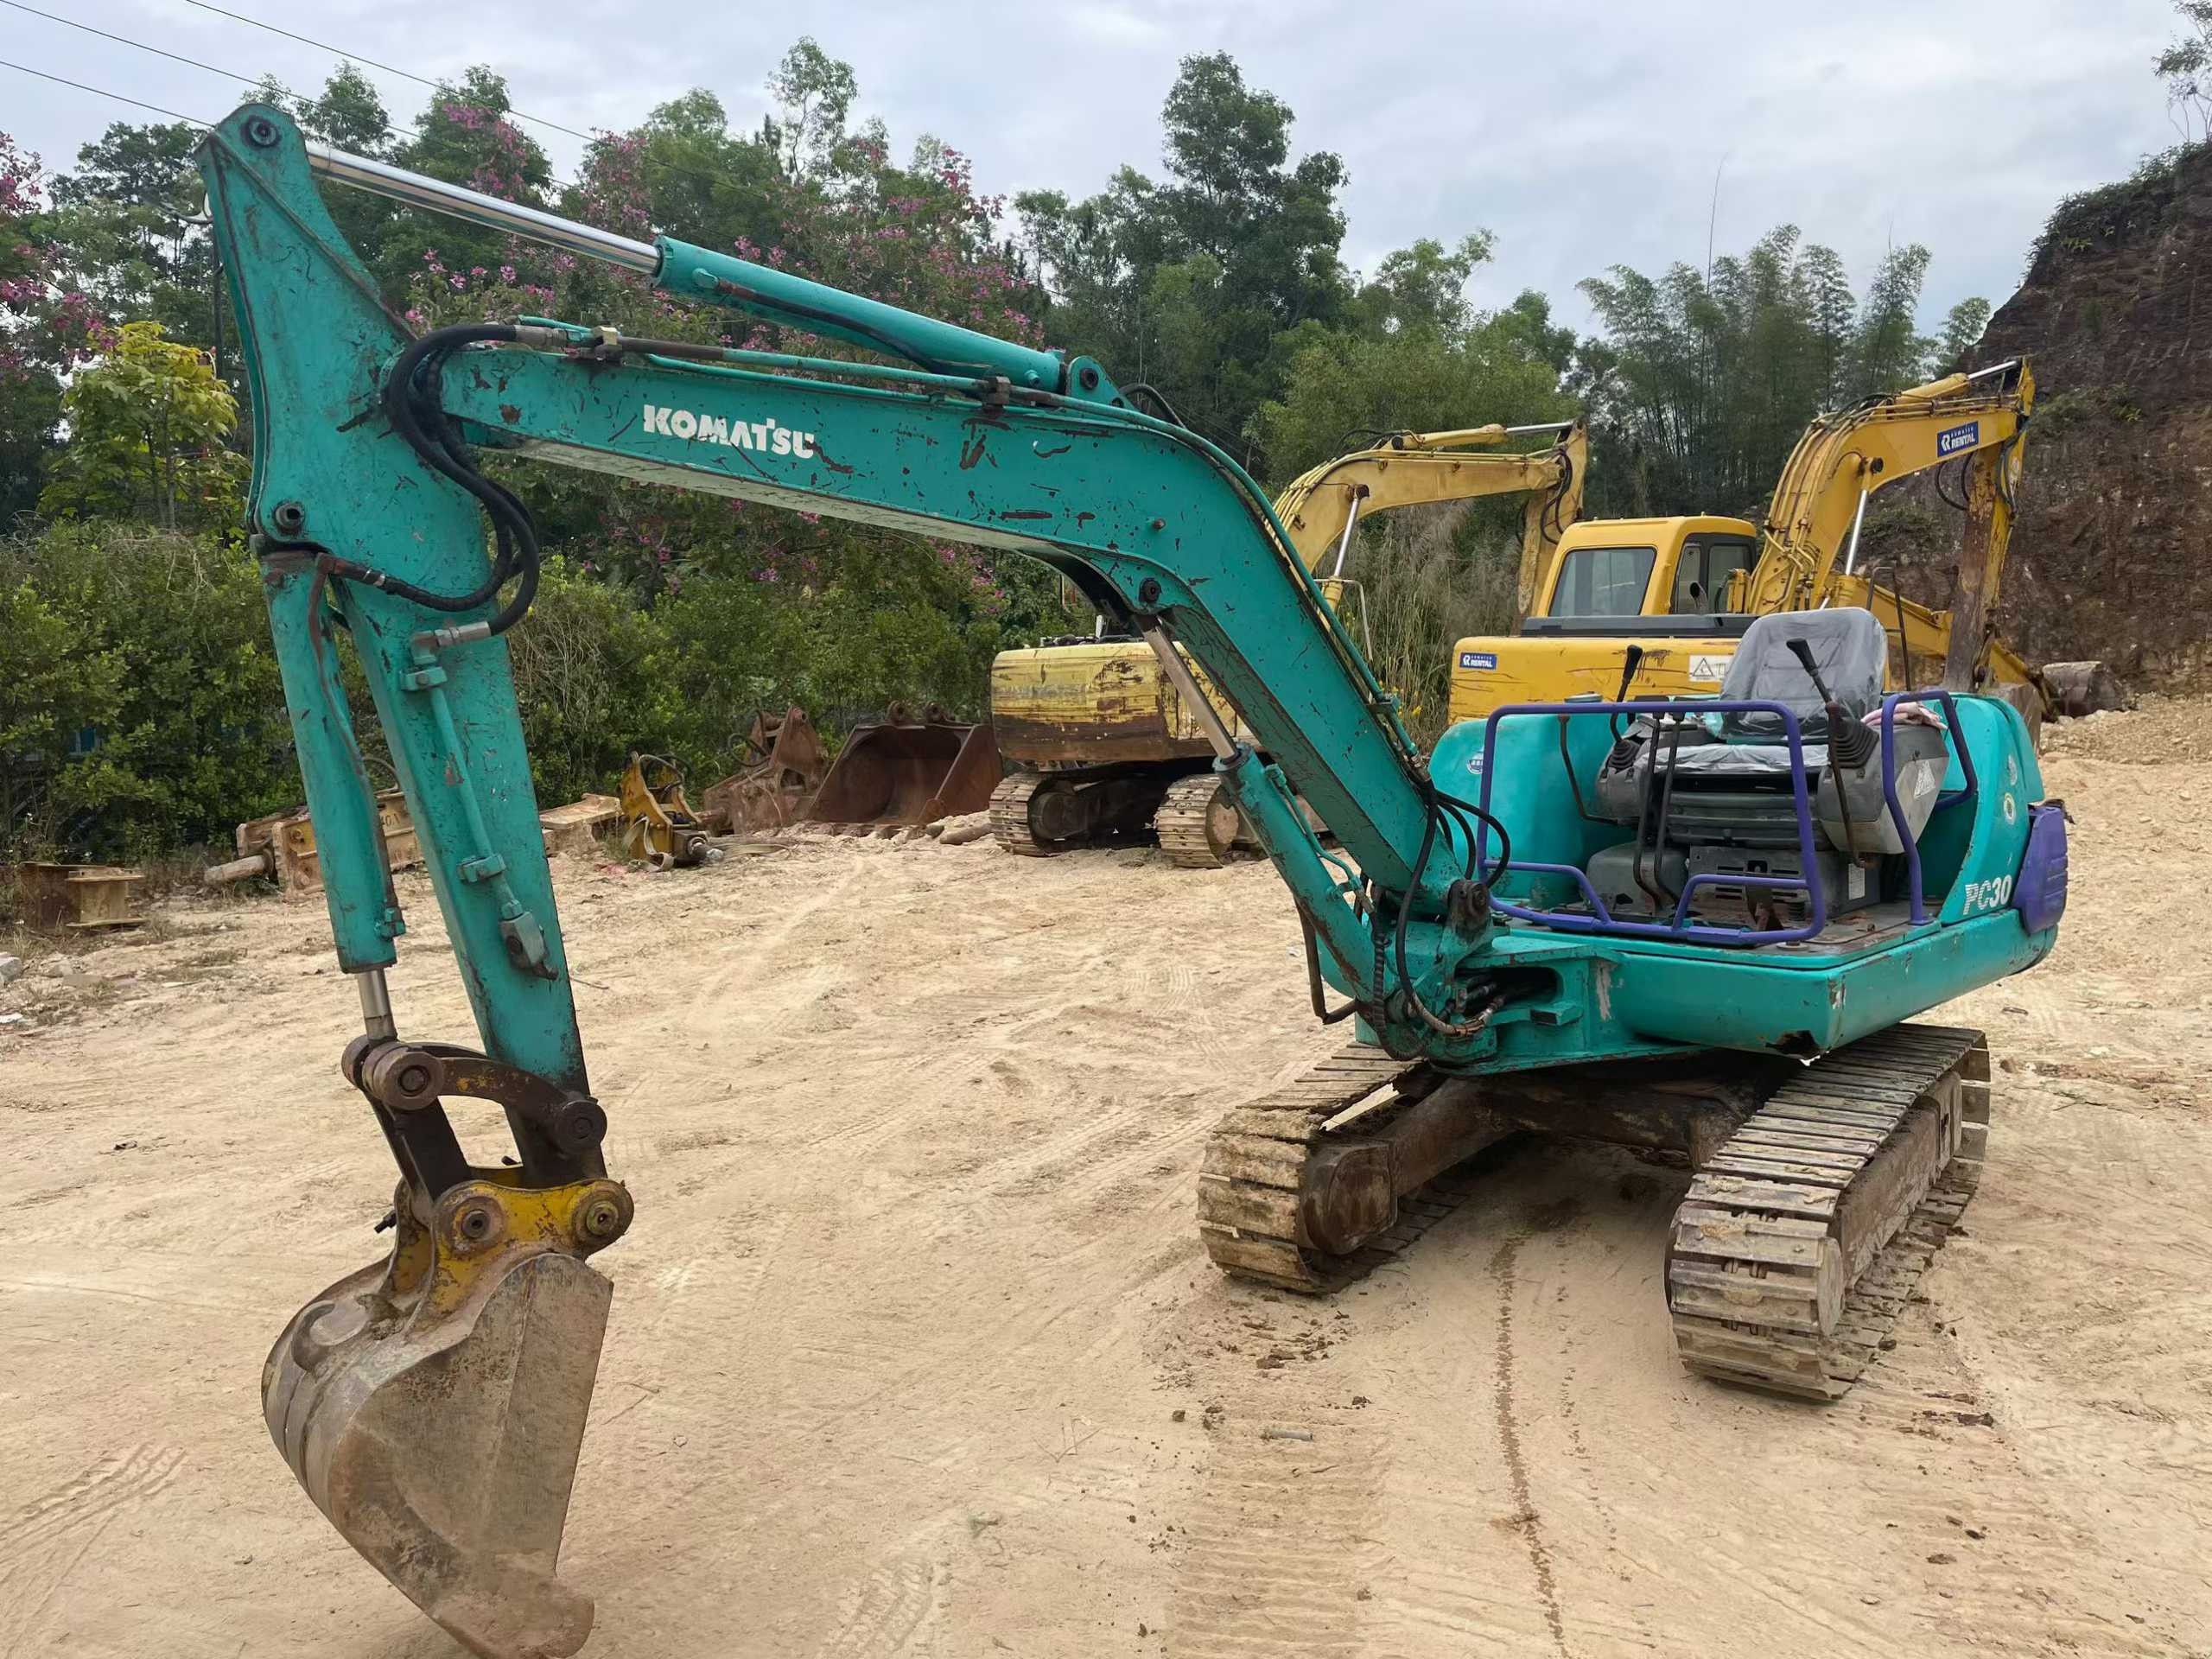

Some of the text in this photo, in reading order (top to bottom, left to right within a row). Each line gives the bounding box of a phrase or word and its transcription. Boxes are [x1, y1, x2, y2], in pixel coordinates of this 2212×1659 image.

[643, 404, 815, 459] KOMATSU
[1951, 432, 1975, 449] RENTAL
[1471, 659, 1493, 668] RENTAL
[1963, 874, 2012, 915] PC30
